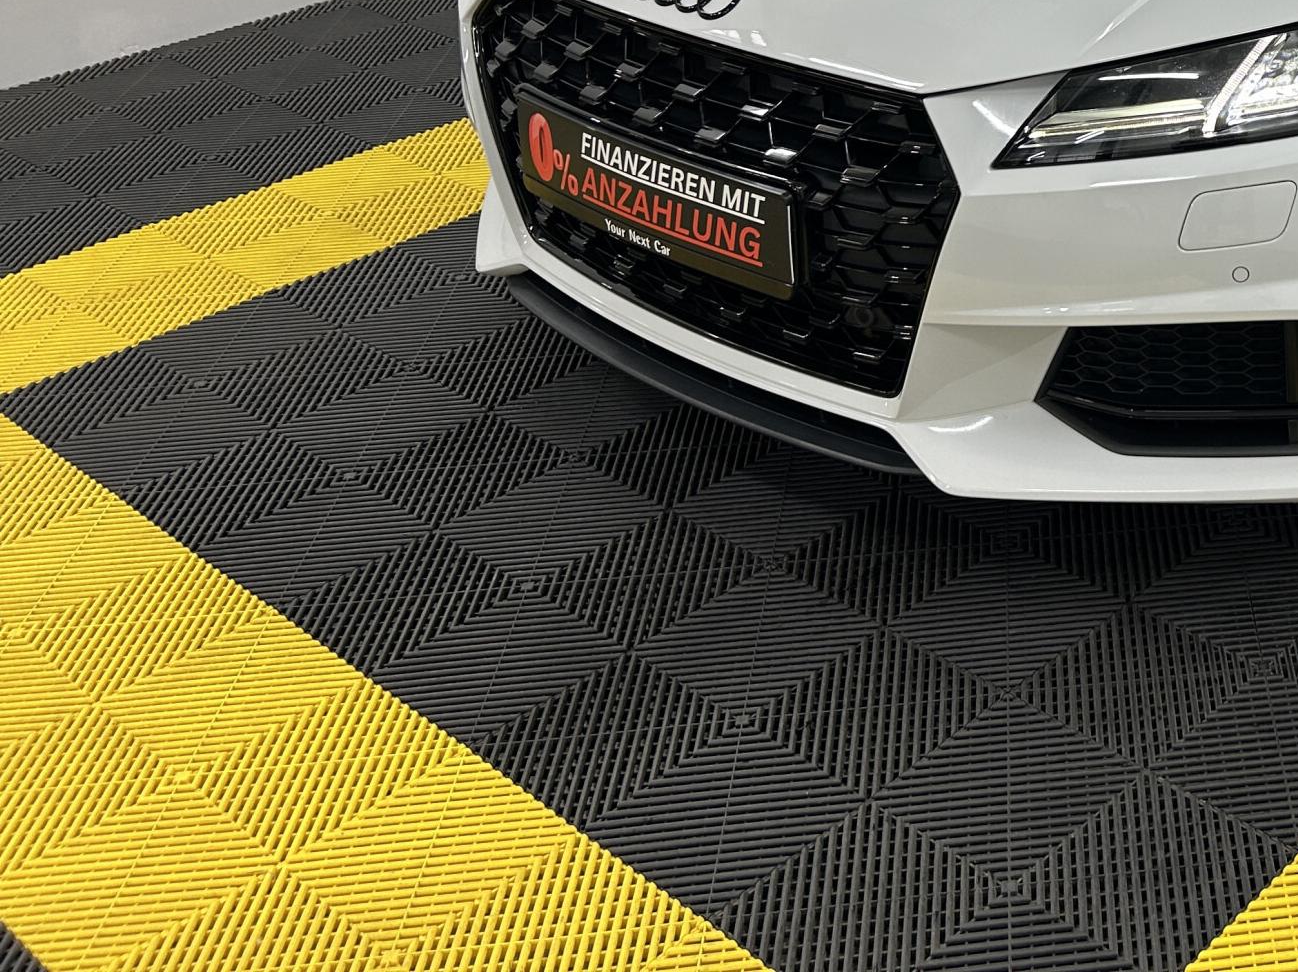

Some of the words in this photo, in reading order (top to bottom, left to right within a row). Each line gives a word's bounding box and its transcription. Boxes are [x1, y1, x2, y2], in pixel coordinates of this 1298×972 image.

[581, 132, 715, 202] FINANZIEREN
[722, 188, 765, 218] MIT
[582, 167, 761, 260] ANZAHLUNG
[605, 219, 625, 239] Your
[629, 229, 650, 249] Next
[654, 240, 671, 256] Car
